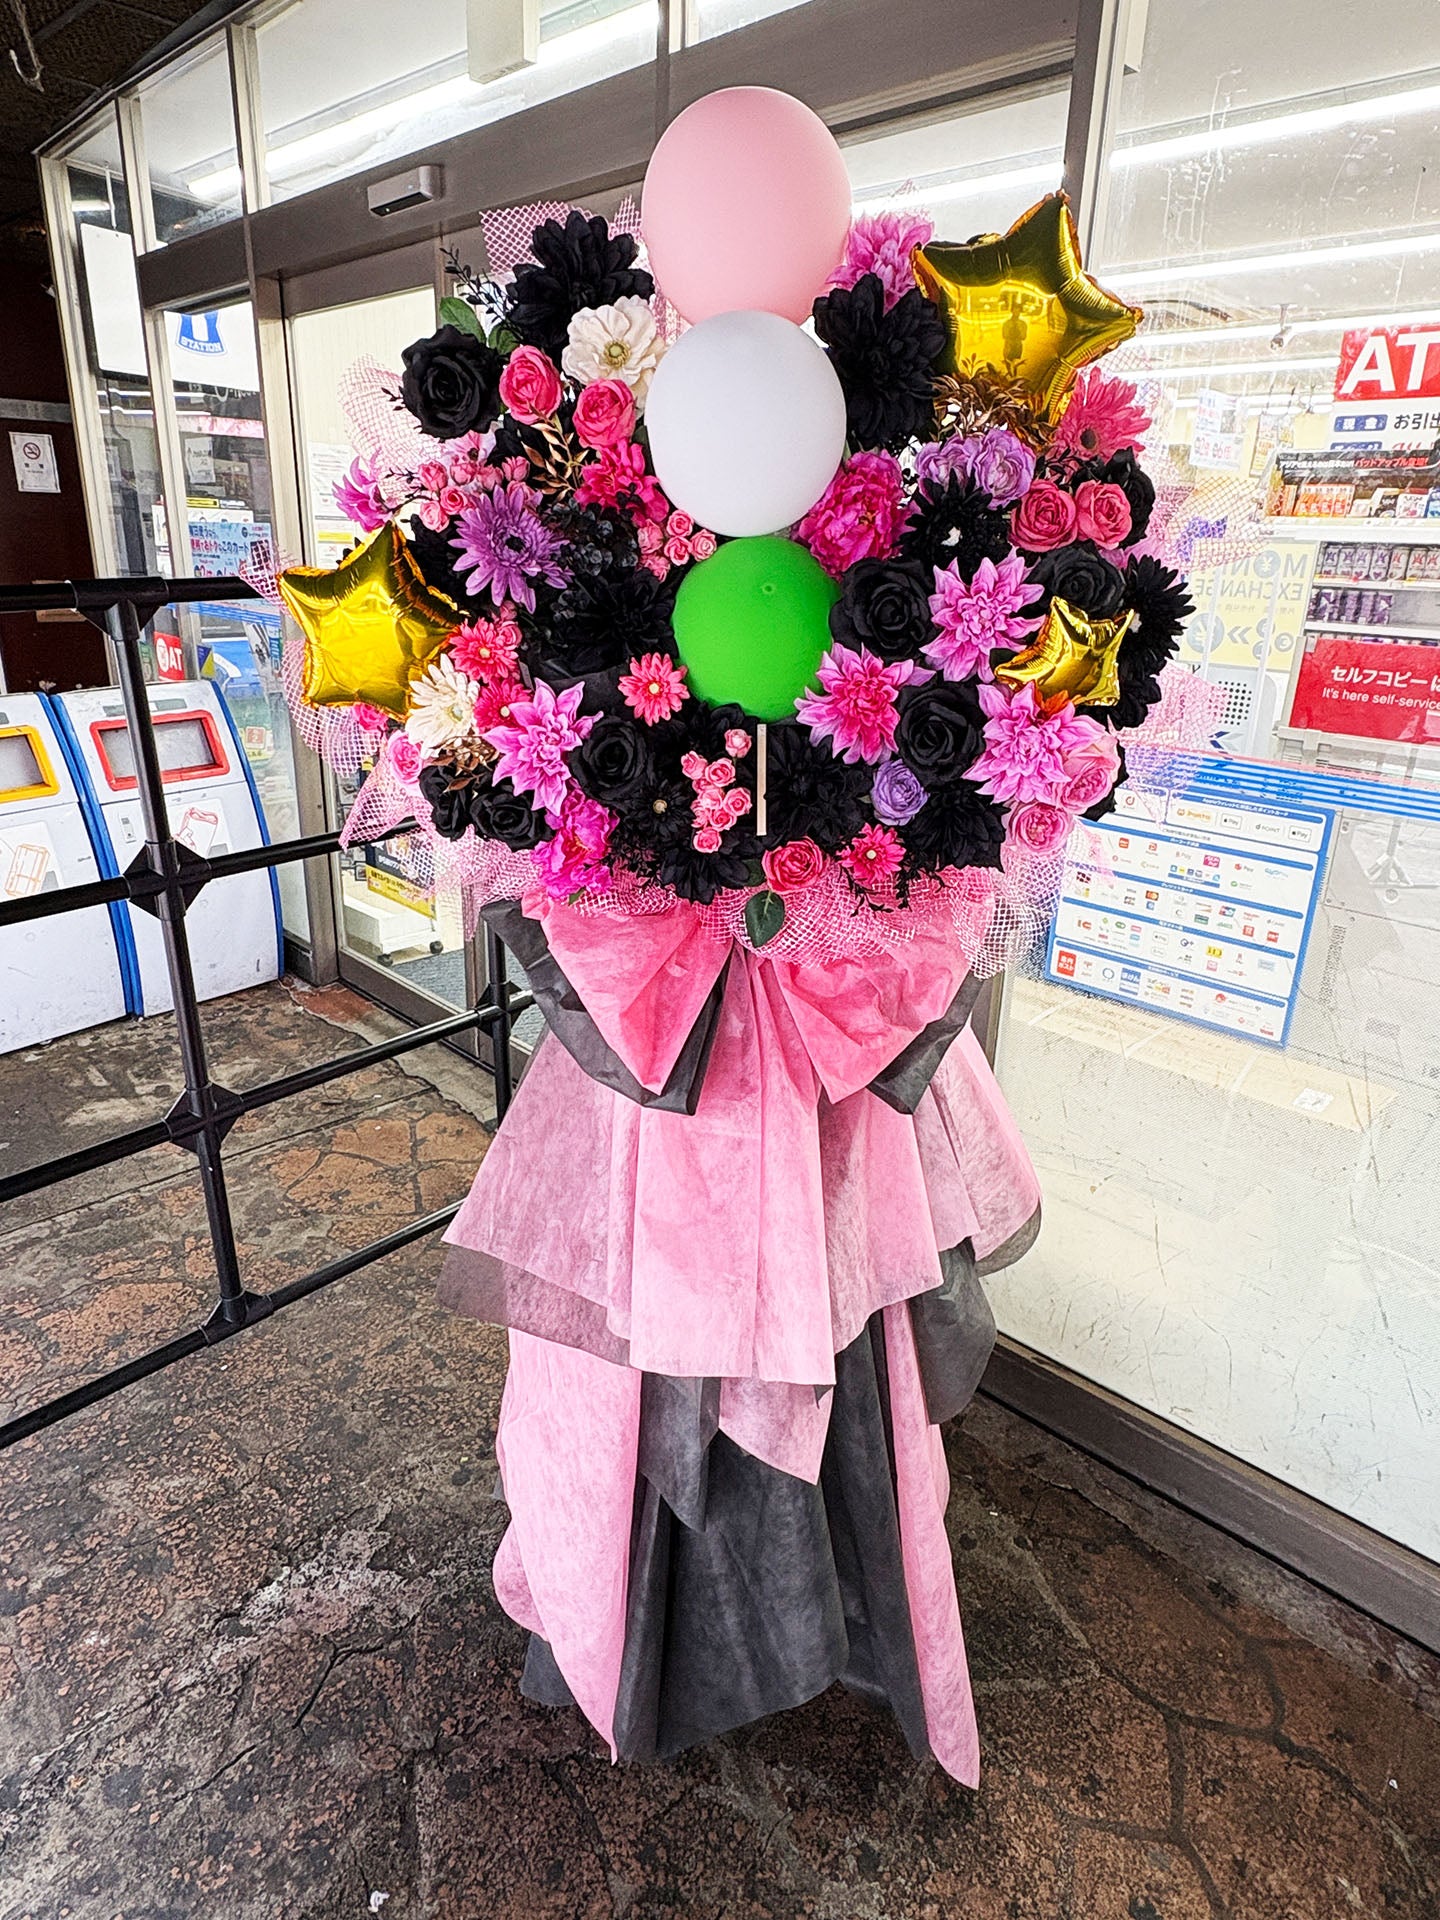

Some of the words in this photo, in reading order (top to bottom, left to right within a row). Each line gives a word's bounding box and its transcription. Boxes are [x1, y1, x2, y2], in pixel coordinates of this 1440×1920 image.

[181, 335, 222, 352] STATION
[1322, 687, 1340, 699] It's
[1342, 689, 1370, 702] here
